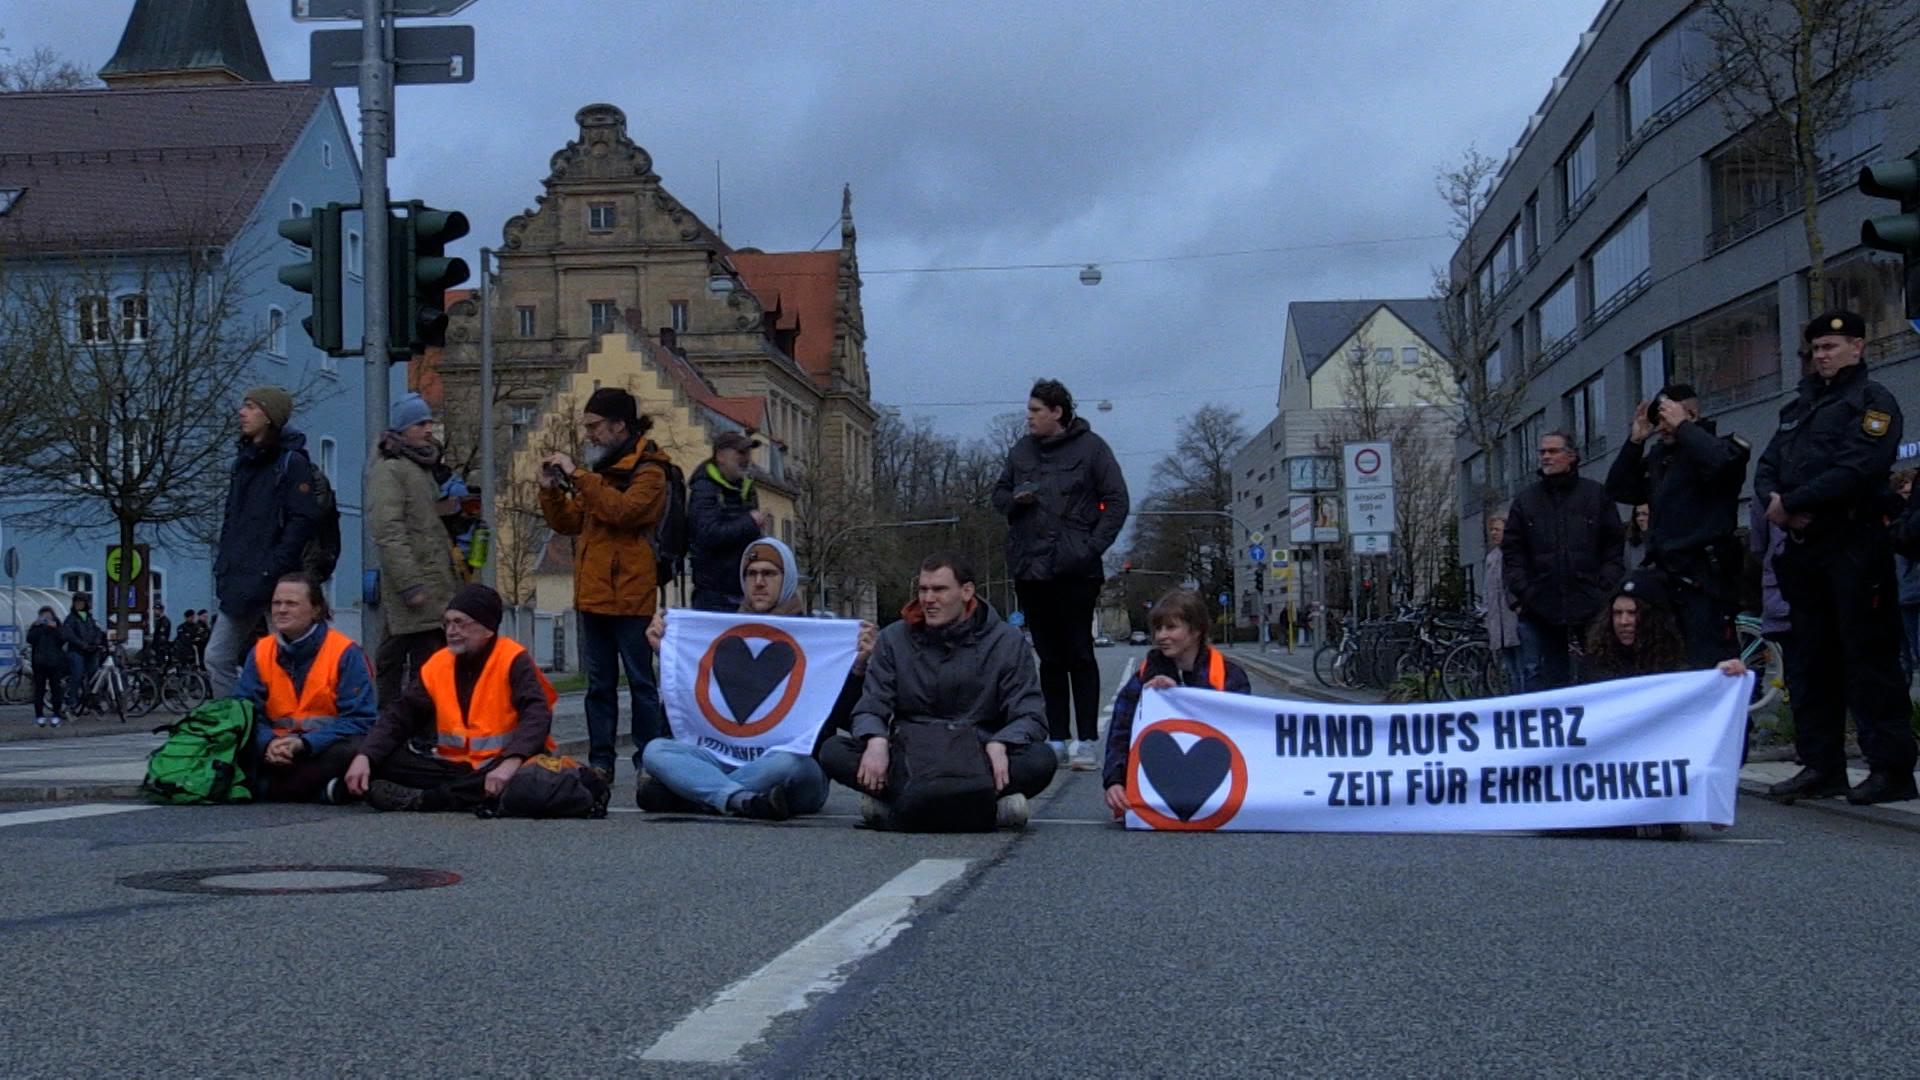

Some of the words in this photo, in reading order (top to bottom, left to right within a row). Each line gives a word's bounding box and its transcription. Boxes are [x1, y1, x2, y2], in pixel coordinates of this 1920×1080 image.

[1275, 713, 1373, 757] HAND
[1388, 711, 1480, 755] AUFS
[1493, 705, 1587, 750] HERZ
[1327, 769, 1393, 806] ZEIT
[1406, 761, 1467, 805] FÜR
[1480, 758, 1690, 804] EHRLICHKEIT
